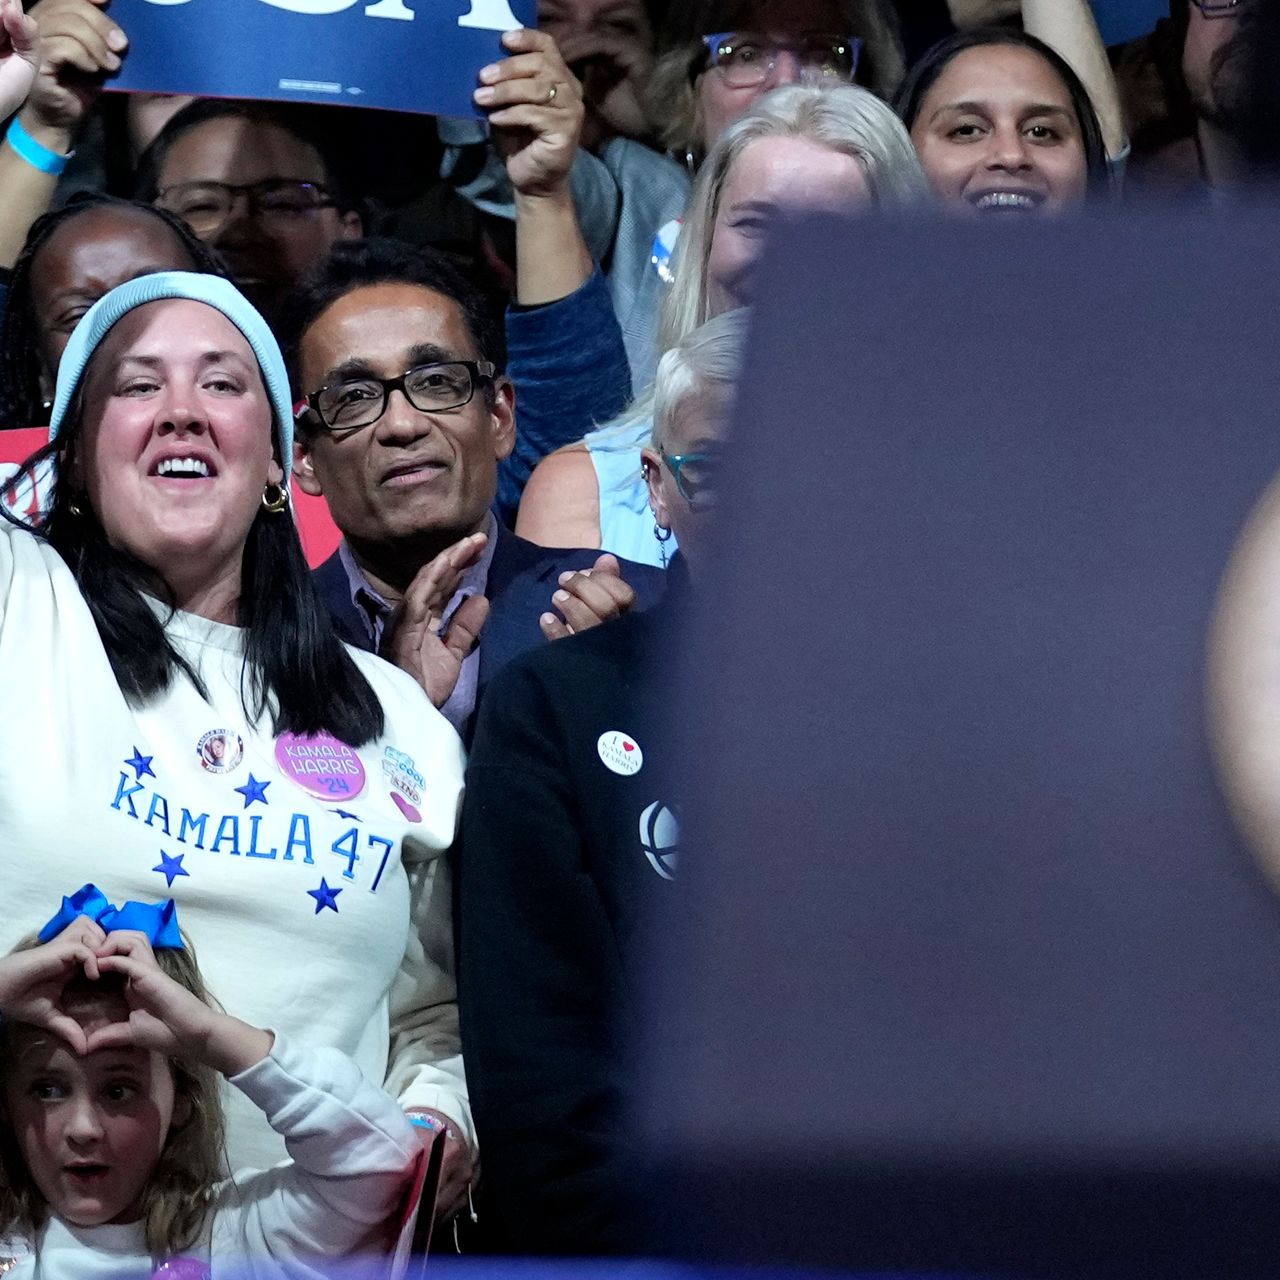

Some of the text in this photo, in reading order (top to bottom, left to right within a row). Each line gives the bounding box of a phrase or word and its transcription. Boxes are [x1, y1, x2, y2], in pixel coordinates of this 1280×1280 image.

[284, 745, 353, 759] KAMALA
[290, 758, 360, 776] HARRIS
[110, 771, 394, 894] KAMALA 47
